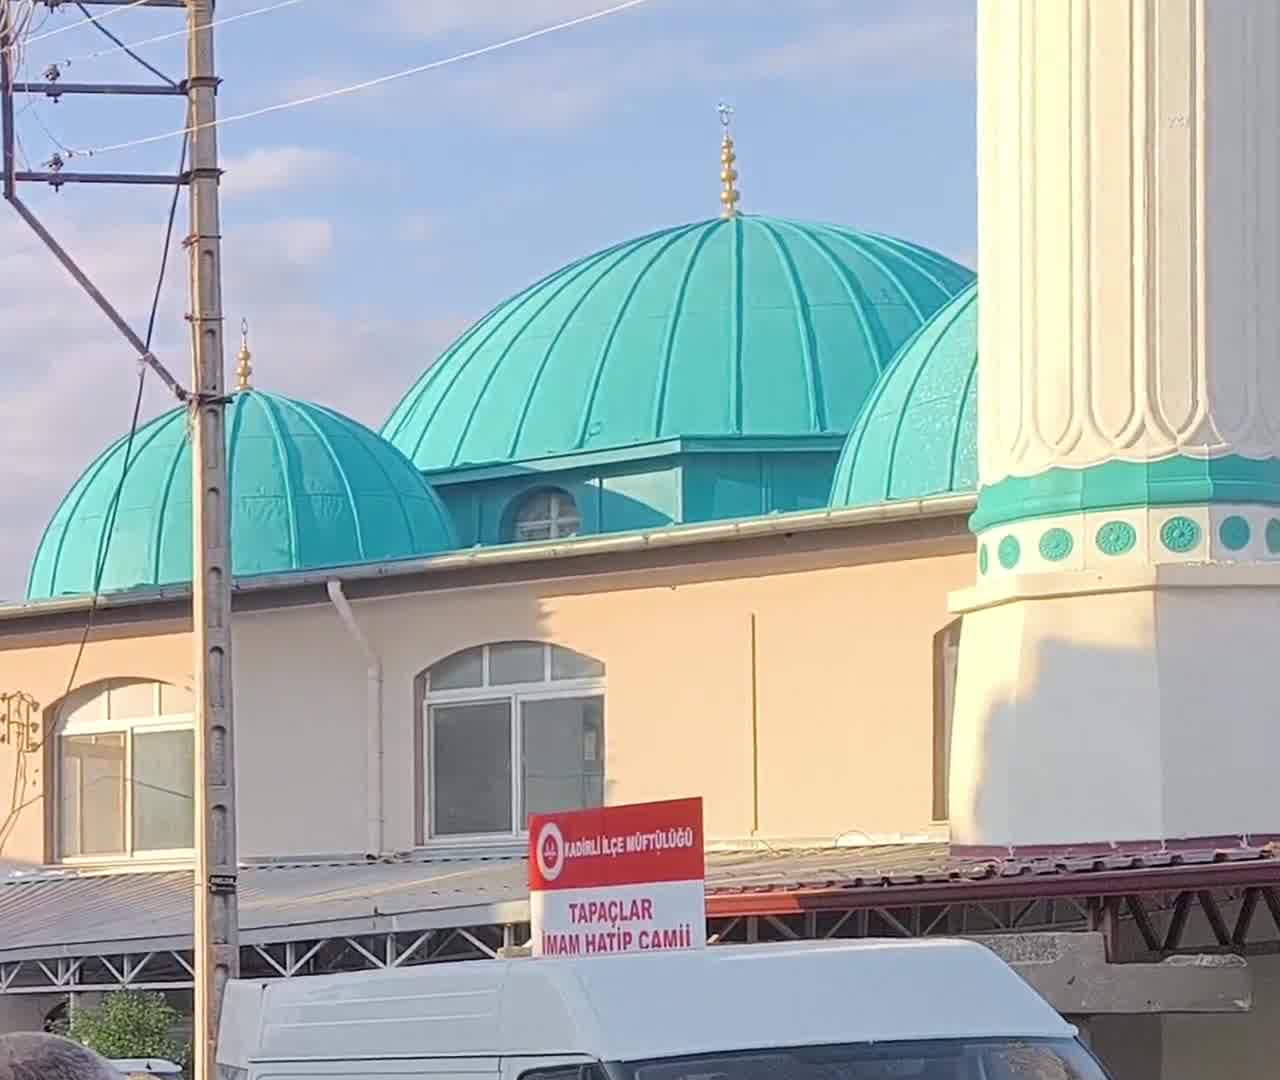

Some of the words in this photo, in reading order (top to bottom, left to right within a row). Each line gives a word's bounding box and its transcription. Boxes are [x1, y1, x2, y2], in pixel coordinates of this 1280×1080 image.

[626, 826, 693, 853] MÜFTÜLÜĞÜ
[569, 898, 653, 928] TAPAÇLAR
[542, 929, 581, 956] İMAM
[586, 927, 633, 952] HATİP
[639, 923, 691, 949] CAMİİ
